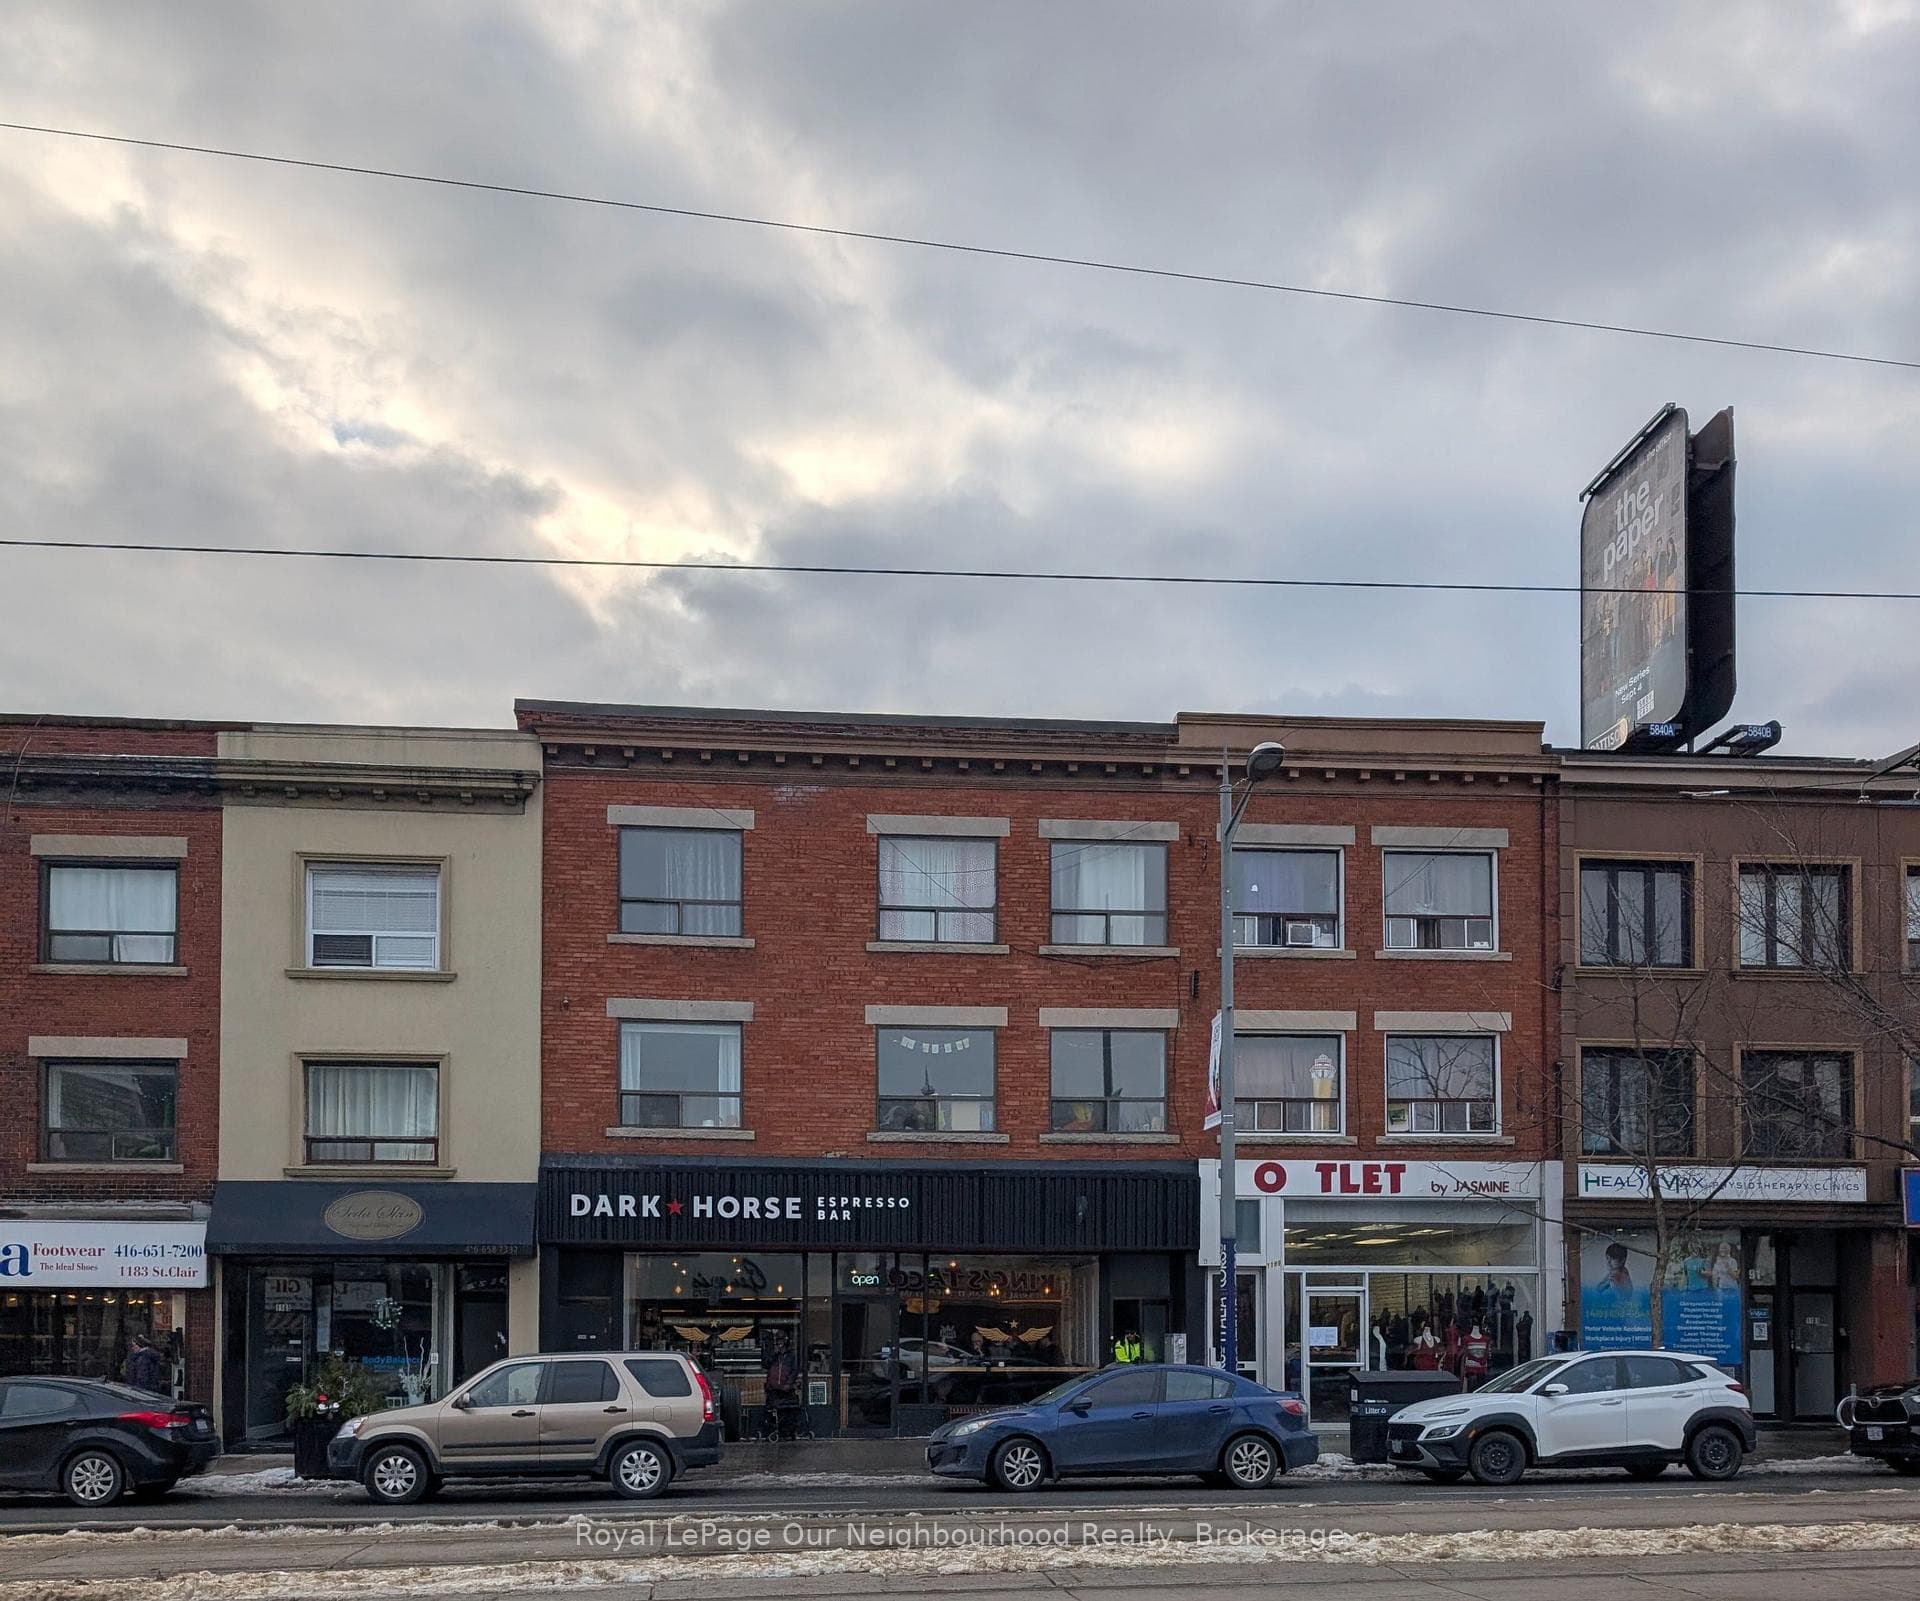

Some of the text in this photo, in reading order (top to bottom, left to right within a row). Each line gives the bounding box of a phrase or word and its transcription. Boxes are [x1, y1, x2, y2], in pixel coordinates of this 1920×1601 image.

[1614, 480, 1650, 532] the
[1603, 493, 1664, 583] paper
[1650, 723, 1675, 736] 5840A
[1748, 726, 1772, 738] 5840B
[1254, 1162, 1510, 1196] O TLET by JASMINE
[570, 1194, 910, 1220] DARK HORSE ESPRESSO
[817, 1210, 852, 1221] BAR
[33, 1243, 105, 1257] Footwear
[114, 1244, 203, 1258] 416-651-7200
[40, 1262, 98, 1271] The Ideal Shoes
[120, 1266, 199, 1278] 1183 St.Clair
[851, 1274, 880, 1287] open
[1365, 1407, 1380, 1415] Litter
